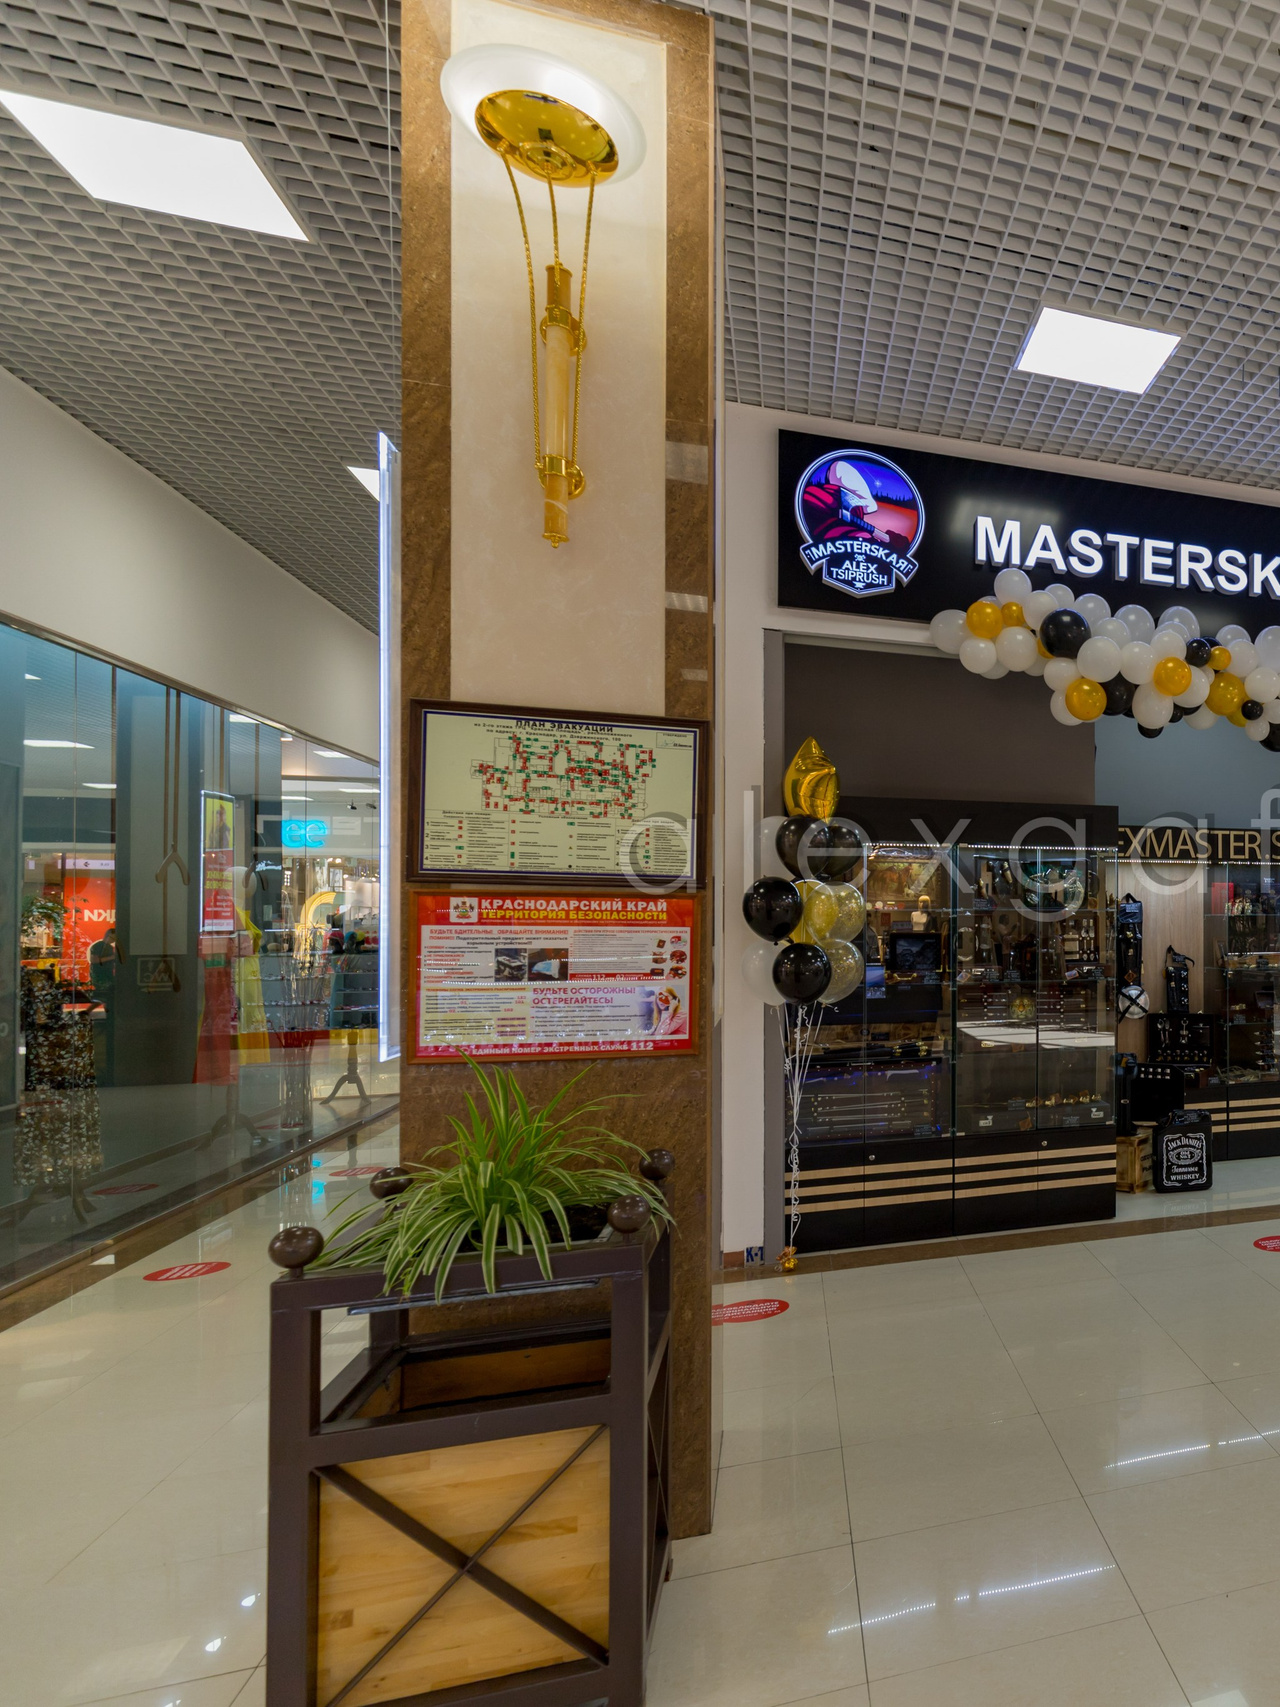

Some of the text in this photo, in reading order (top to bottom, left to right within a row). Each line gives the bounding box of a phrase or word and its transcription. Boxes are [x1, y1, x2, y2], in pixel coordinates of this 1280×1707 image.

[842, 560, 878, 574] ALEX
[830, 567, 888, 586] TSIPRUSH
[515, 720, 614, 733] ПЛАН ЭВАКУАЦИИ
[481, 898, 668, 912] КРАСНОДАРСКИЙ КРАЙ
[482, 910, 667, 920] ТЕРРИТОРИЯ БЕЗОПАСНОСТИ
[532, 987, 636, 996] БУДЬТЕ ОСТОРОЖНЫ!
[532, 996, 614, 1005] ОСТЕРЕГАЙТЕСЬ!
[472, 1041, 654, 1055] ЕДИНЫЙ НОМЕР ЭКСТРЕННЫХ СЛУЖБ 112
[1170, 1173, 1200, 1181] WHISKEY
